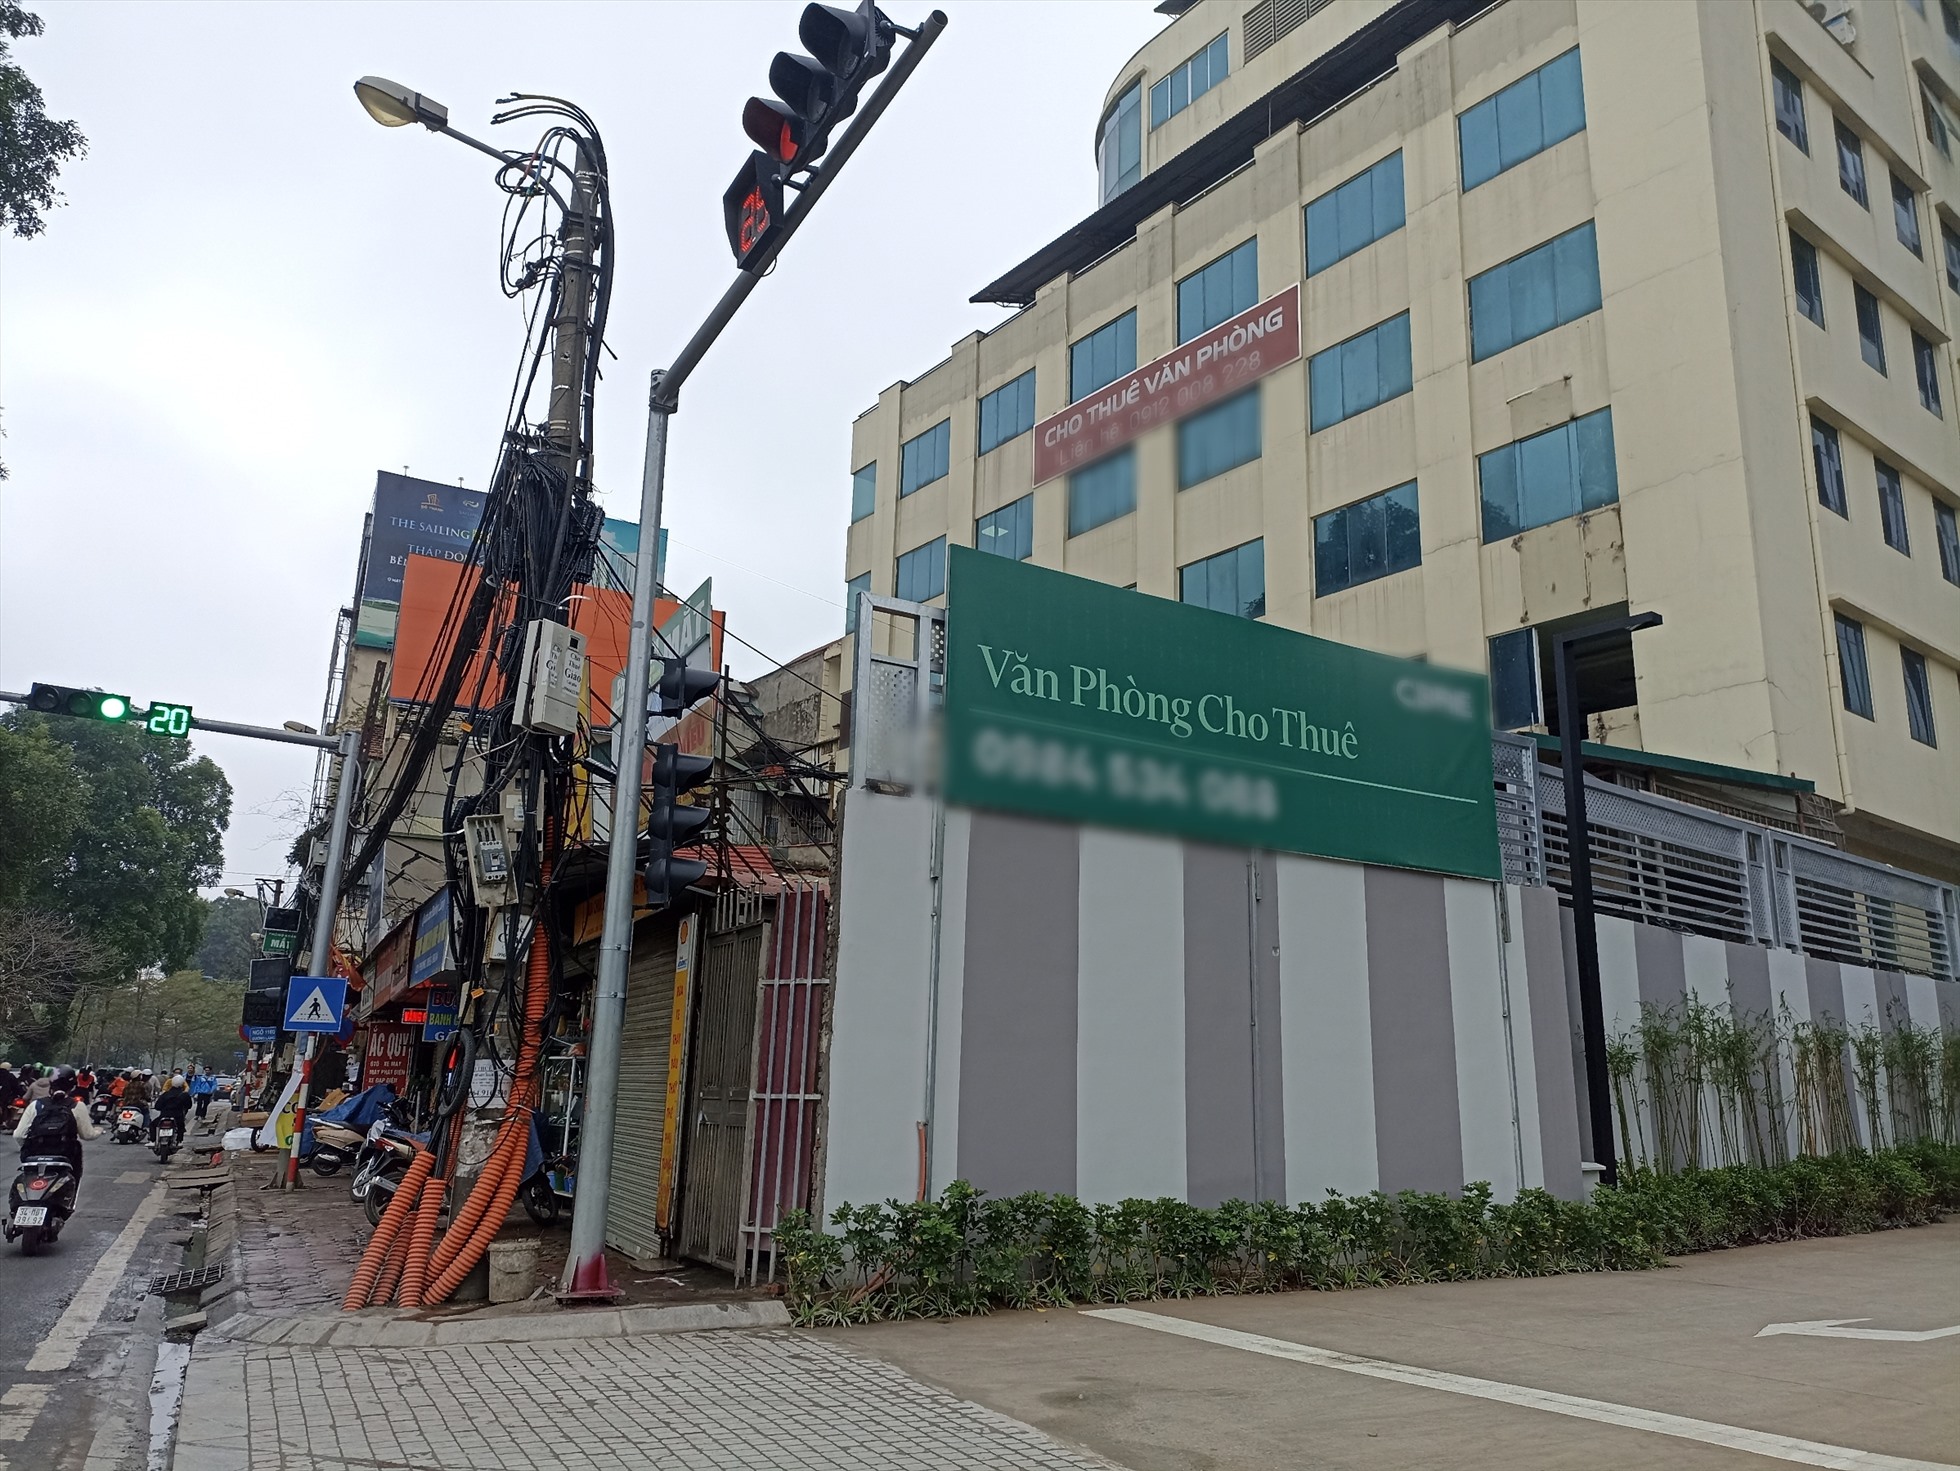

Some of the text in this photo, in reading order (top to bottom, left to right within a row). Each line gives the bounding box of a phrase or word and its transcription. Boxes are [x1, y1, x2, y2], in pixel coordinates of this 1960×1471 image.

[1044, 306, 1284, 448] CHO THUÊ VĂN PHÒNG
[1222, 350, 1262, 384] 228
[390, 516, 417, 531] THE
[419, 521, 471, 540] SAILING
[977, 643, 1359, 761] Văn Phòng Cho Thuê
[150, 705, 189, 735] 20
[387, 1032, 410, 1060] QUY
